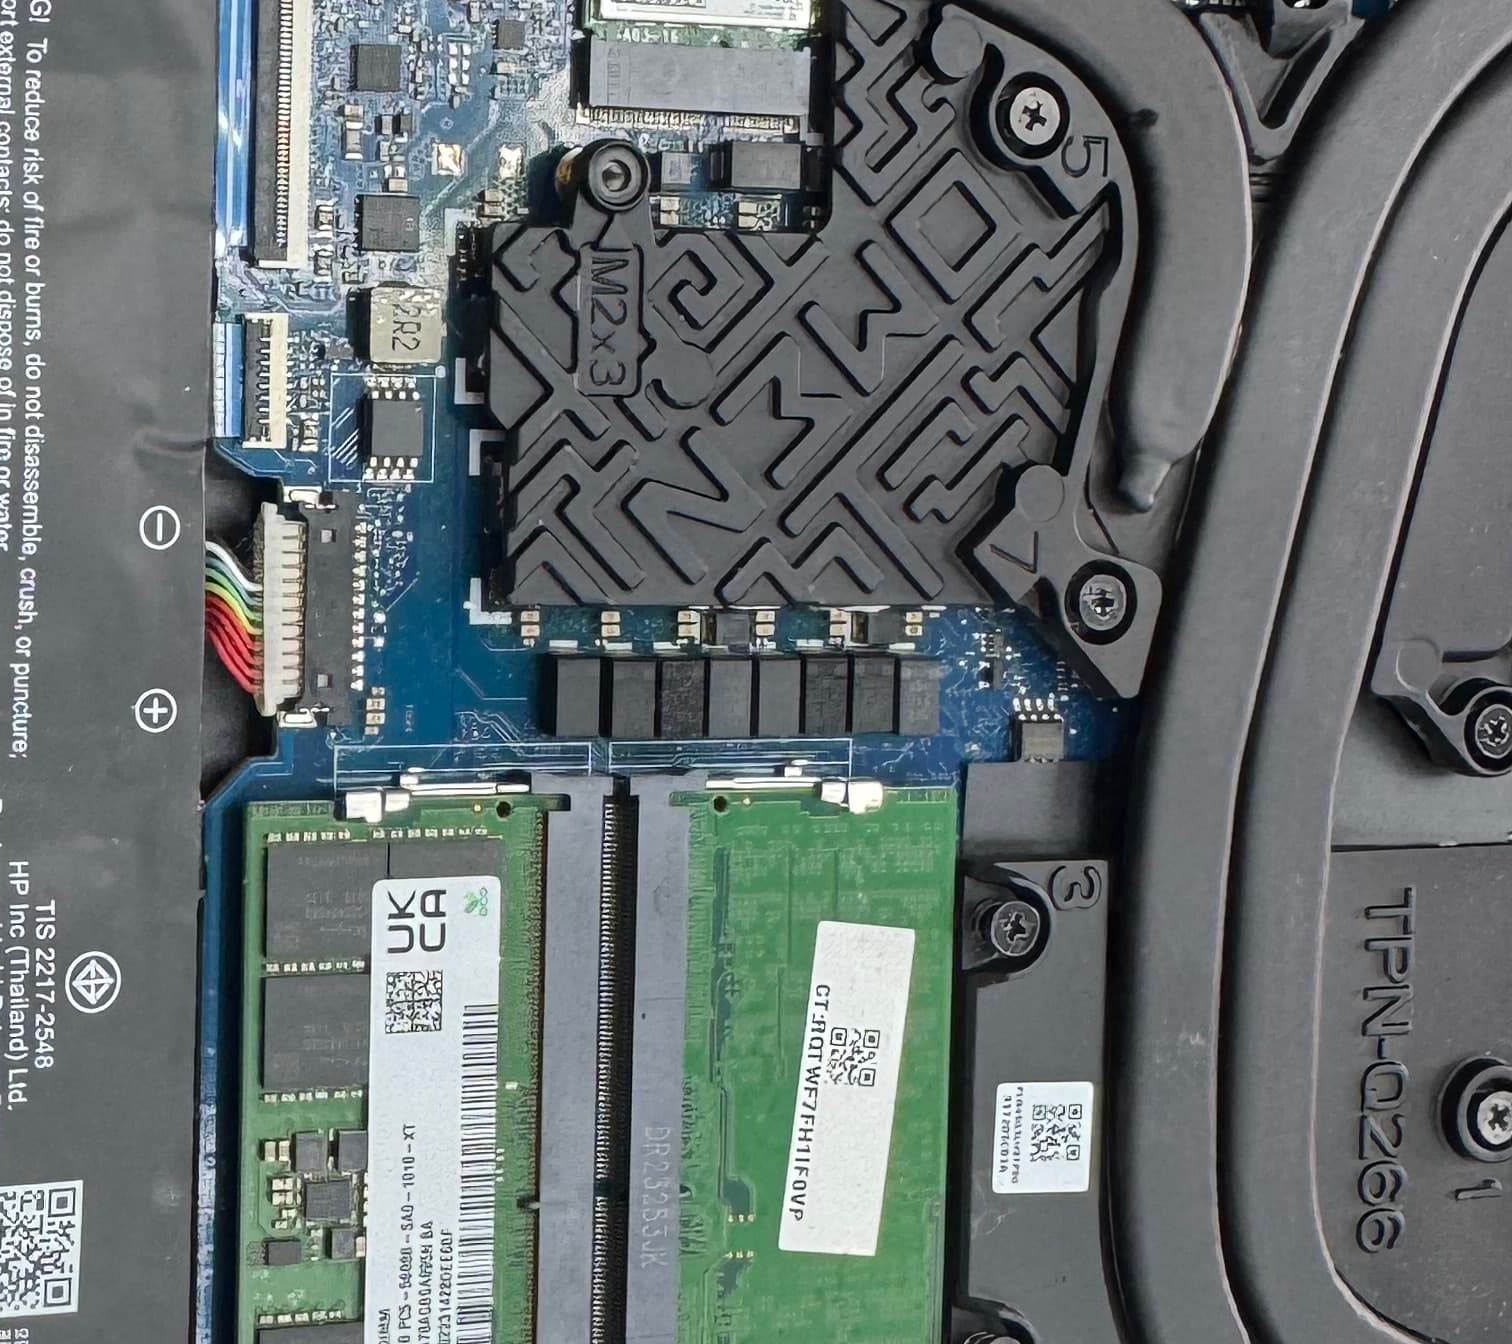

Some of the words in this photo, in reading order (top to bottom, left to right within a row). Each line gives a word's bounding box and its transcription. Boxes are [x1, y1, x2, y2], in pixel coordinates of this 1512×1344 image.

[26, 38, 48, 63] To
[24, 70, 45, 141] reduce
[23, 148, 44, 184] risk
[1061, 135, 1109, 180] 5
[23, 192, 44, 212] of
[24, 217, 44, 249] fire
[25, 255, 40, 276] or
[23, 282, 46, 346] burns,
[590, 256, 630, 387] M2x3
[25, 354, 46, 379] do
[25, 386, 44, 420] not
[18, 425, 45, 561] disassemble,
[990, 531, 1037, 575] 7
[14, 568, 38, 630] crush,
[16, 636, 32, 657] or
[9, 663, 32, 758] puncture;
[8, 861, 29, 895] HP
[1051, 865, 1101, 911] 3
[9, 904, 29, 937] Inc
[35, 899, 55, 939] TIS
[387, 894, 415, 954] UK
[4, 946, 30, 1060] (Thailand)
[34, 948, 55, 1068] 2217-2548
[8, 1069, 28, 1110] Ltd.
[1357, 888, 1415, 1254] TPN-Q266
[1454, 1179, 1501, 1200] 1
